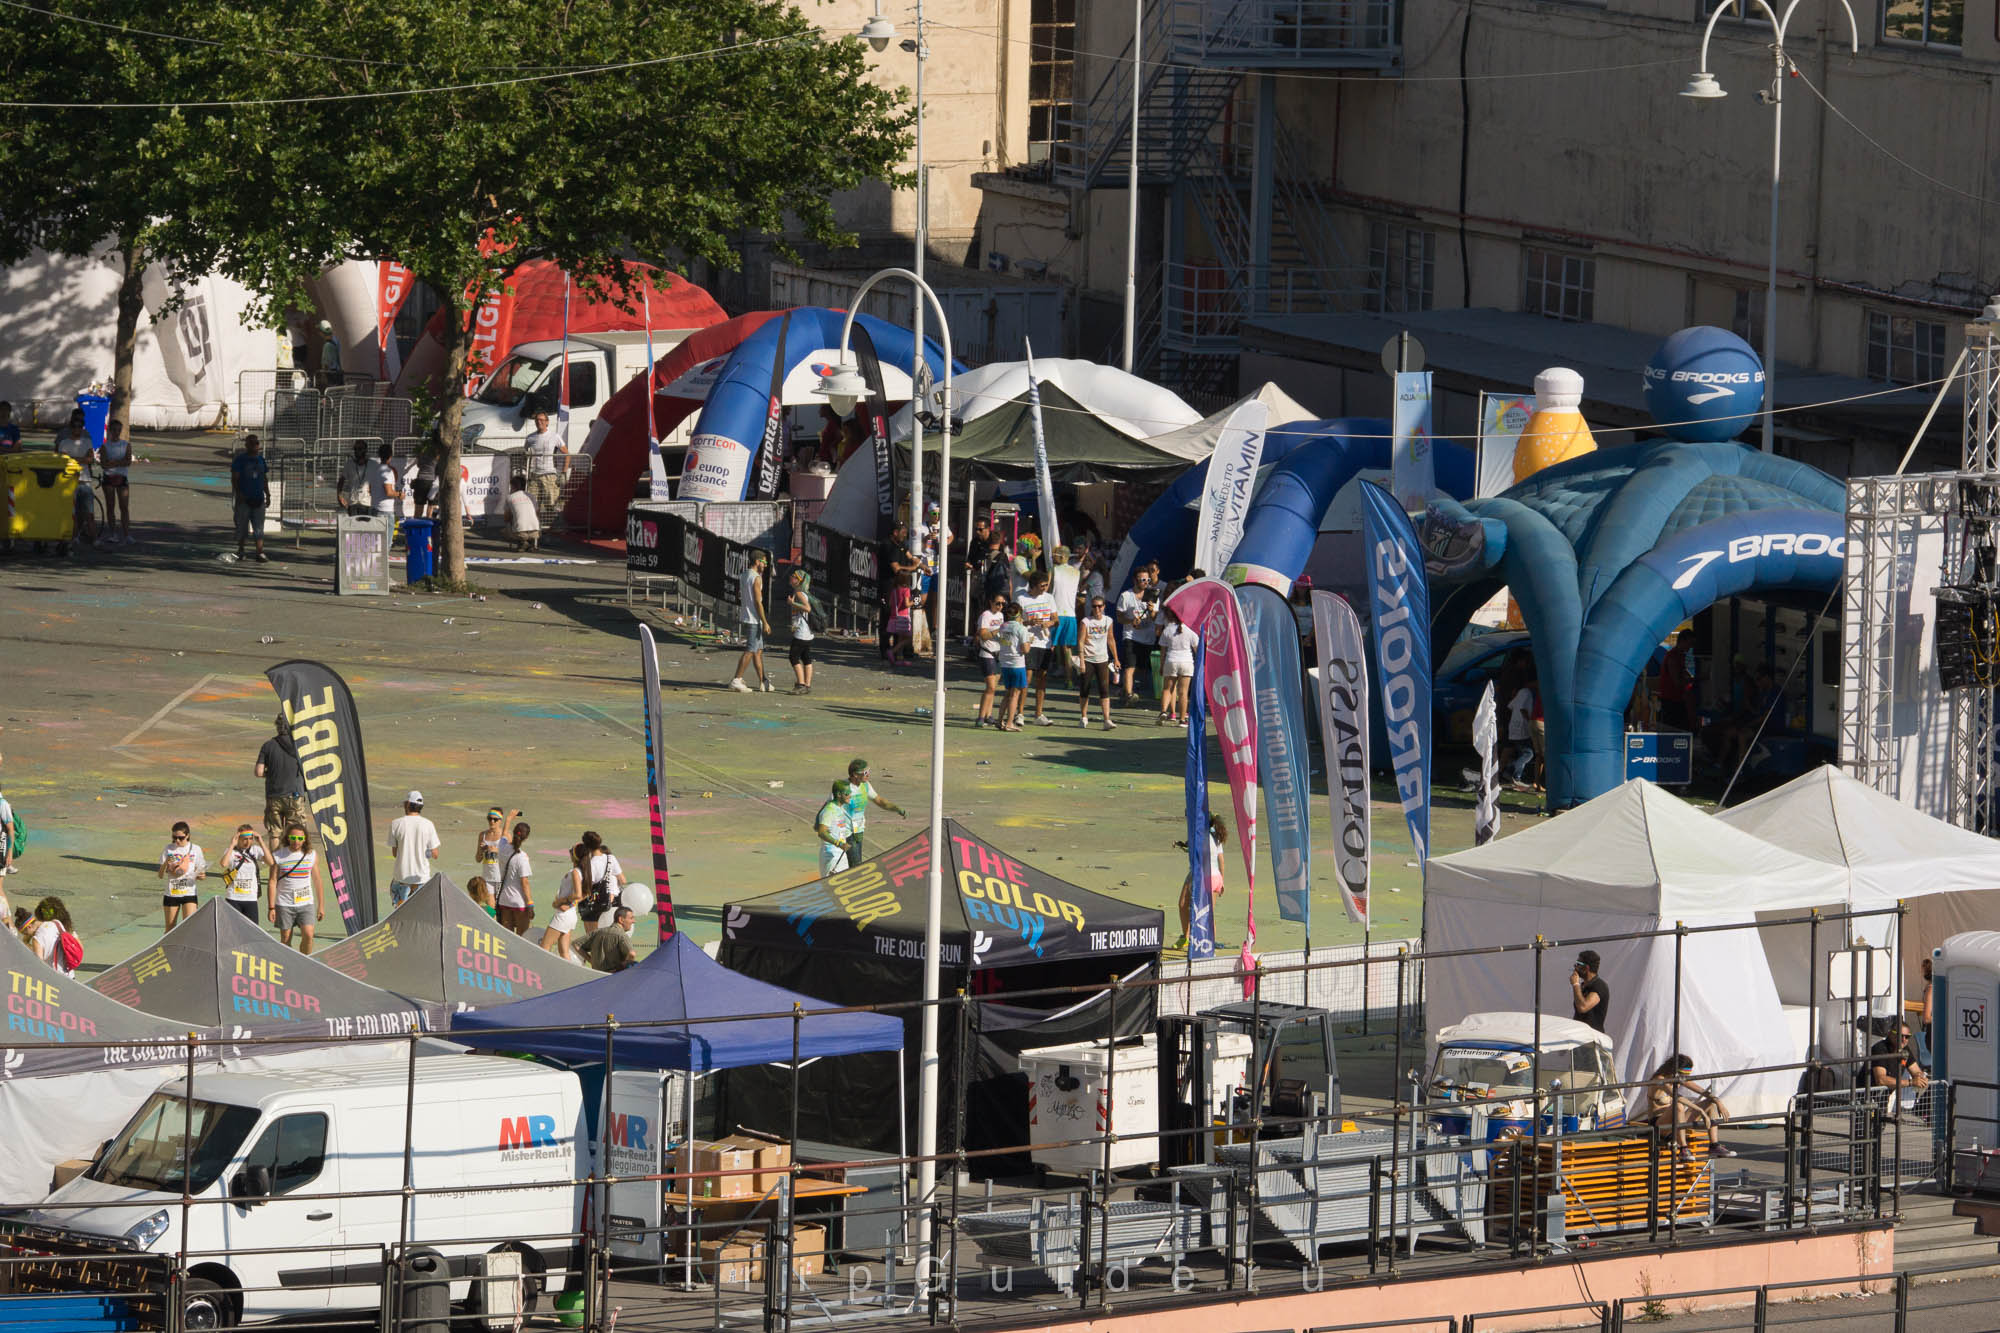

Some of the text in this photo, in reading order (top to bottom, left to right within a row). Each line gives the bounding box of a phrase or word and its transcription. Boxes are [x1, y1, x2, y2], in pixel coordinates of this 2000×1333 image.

[1671, 370, 1749, 383] BROOKS
[472, 475, 499, 488] europ
[699, 462, 730, 477] europ
[953, 836, 1030, 887] THE
[828, 862, 902, 932] COLOR
[959, 870, 1086, 932] COLOR
[965, 897, 1045, 951] RUN
[1090, 932, 1108, 950] THE
[1109, 929, 1138, 949] COLOR
[457, 924, 507, 959] THE
[875, 936, 896, 956] THE
[899, 939, 927, 960] COLO
[232, 951, 284, 986] THE
[457, 949, 543, 990] COLOR
[458, 967, 513, 997] RUN
[8, 970, 60, 1007] THE
[232, 975, 321, 1013] COLOR
[7, 994, 97, 1037] COLOR
[233, 996, 290, 1021] RUN
[8, 1014, 65, 1043] RUN
[326, 1018, 353, 1038] THE
[356, 1013, 398, 1036] COLOR
[1446, 1048, 1503, 1058] Agriturismo.it
